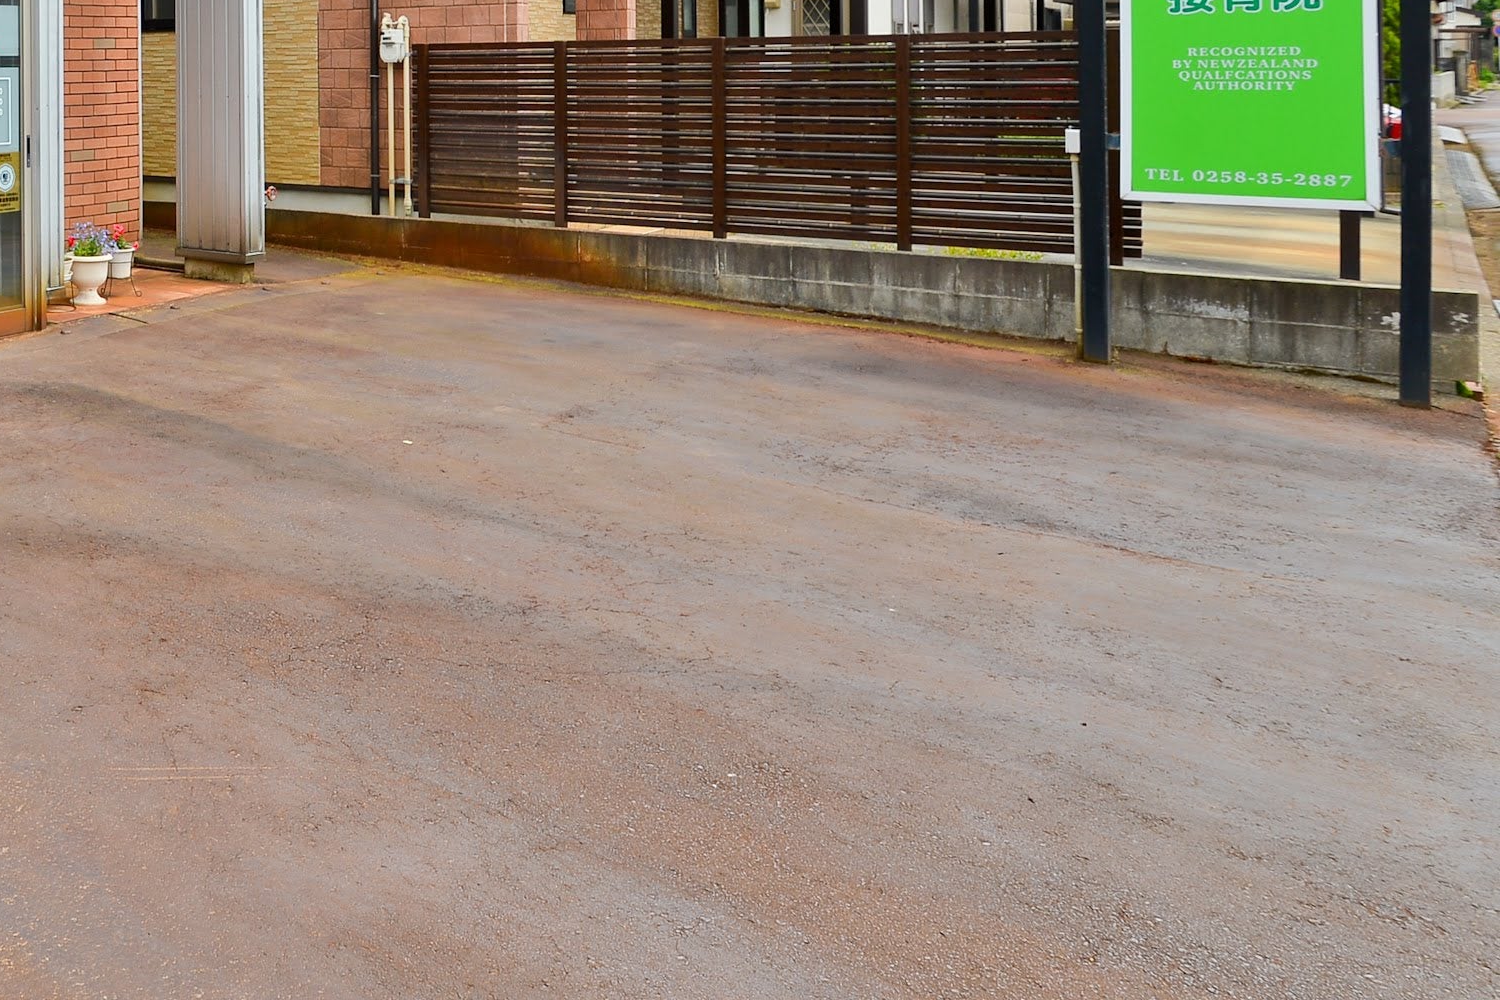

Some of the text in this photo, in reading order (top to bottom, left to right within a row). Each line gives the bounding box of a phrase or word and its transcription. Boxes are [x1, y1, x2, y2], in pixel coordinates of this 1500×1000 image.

[1187, 46, 1301, 57] RECOGNIZED
[1172, 58, 1318, 69] BY NEWZEALAND
[1178, 70, 1312, 81] QUALFCATIONS
[1193, 81, 1295, 91] AUTHORITY
[1144, 168, 1353, 188] TEL 0258-35-2887
